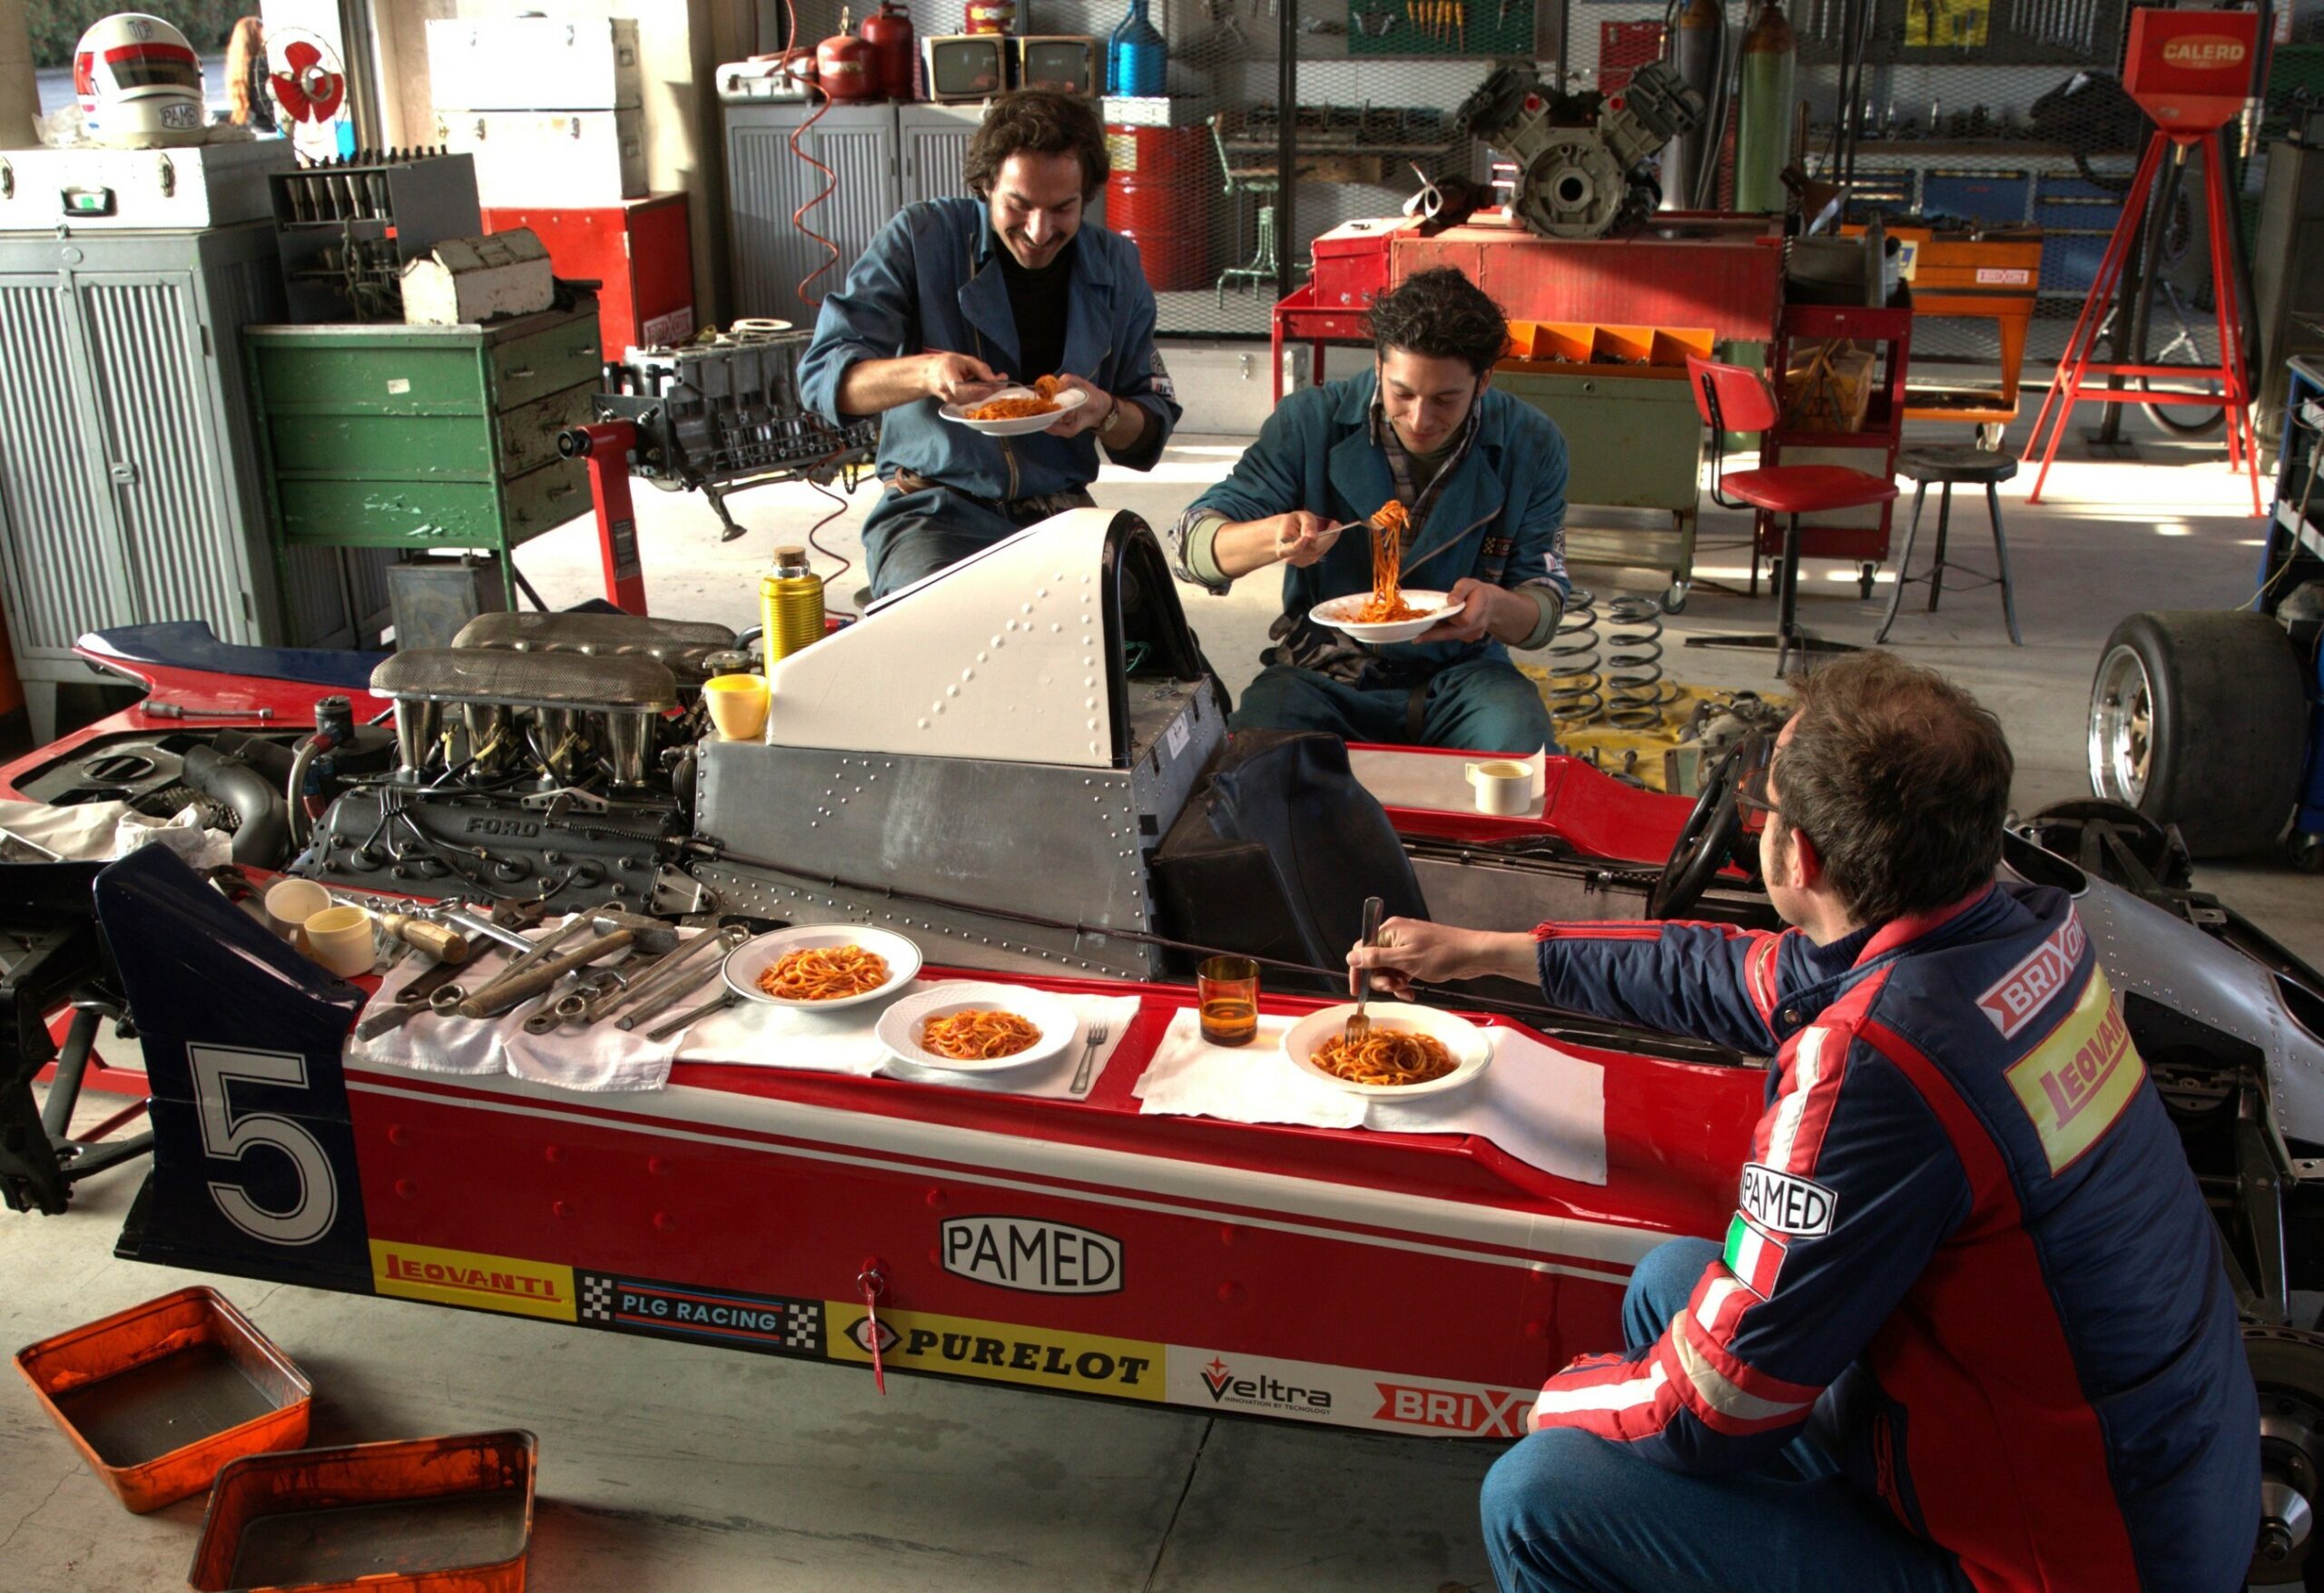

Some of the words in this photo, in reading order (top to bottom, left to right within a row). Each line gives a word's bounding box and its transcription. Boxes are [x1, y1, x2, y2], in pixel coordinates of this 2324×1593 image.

[465, 817, 540, 838] FORD
[2039, 1001, 2125, 1132] LEOVAN
[186, 1041, 338, 1246] 5
[1743, 1172, 1827, 1230] PAMED
[386, 1254, 555, 1296] LEOVANTI
[949, 1224, 1116, 1286] PAMED
[623, 1294, 669, 1316] PLG
[676, 1303, 777, 1332] RACING
[905, 1328, 1150, 1385] PURELOT
[1200, 1372, 1332, 1408] Veltra
[1225, 1396, 1271, 1408] INNOVATION
